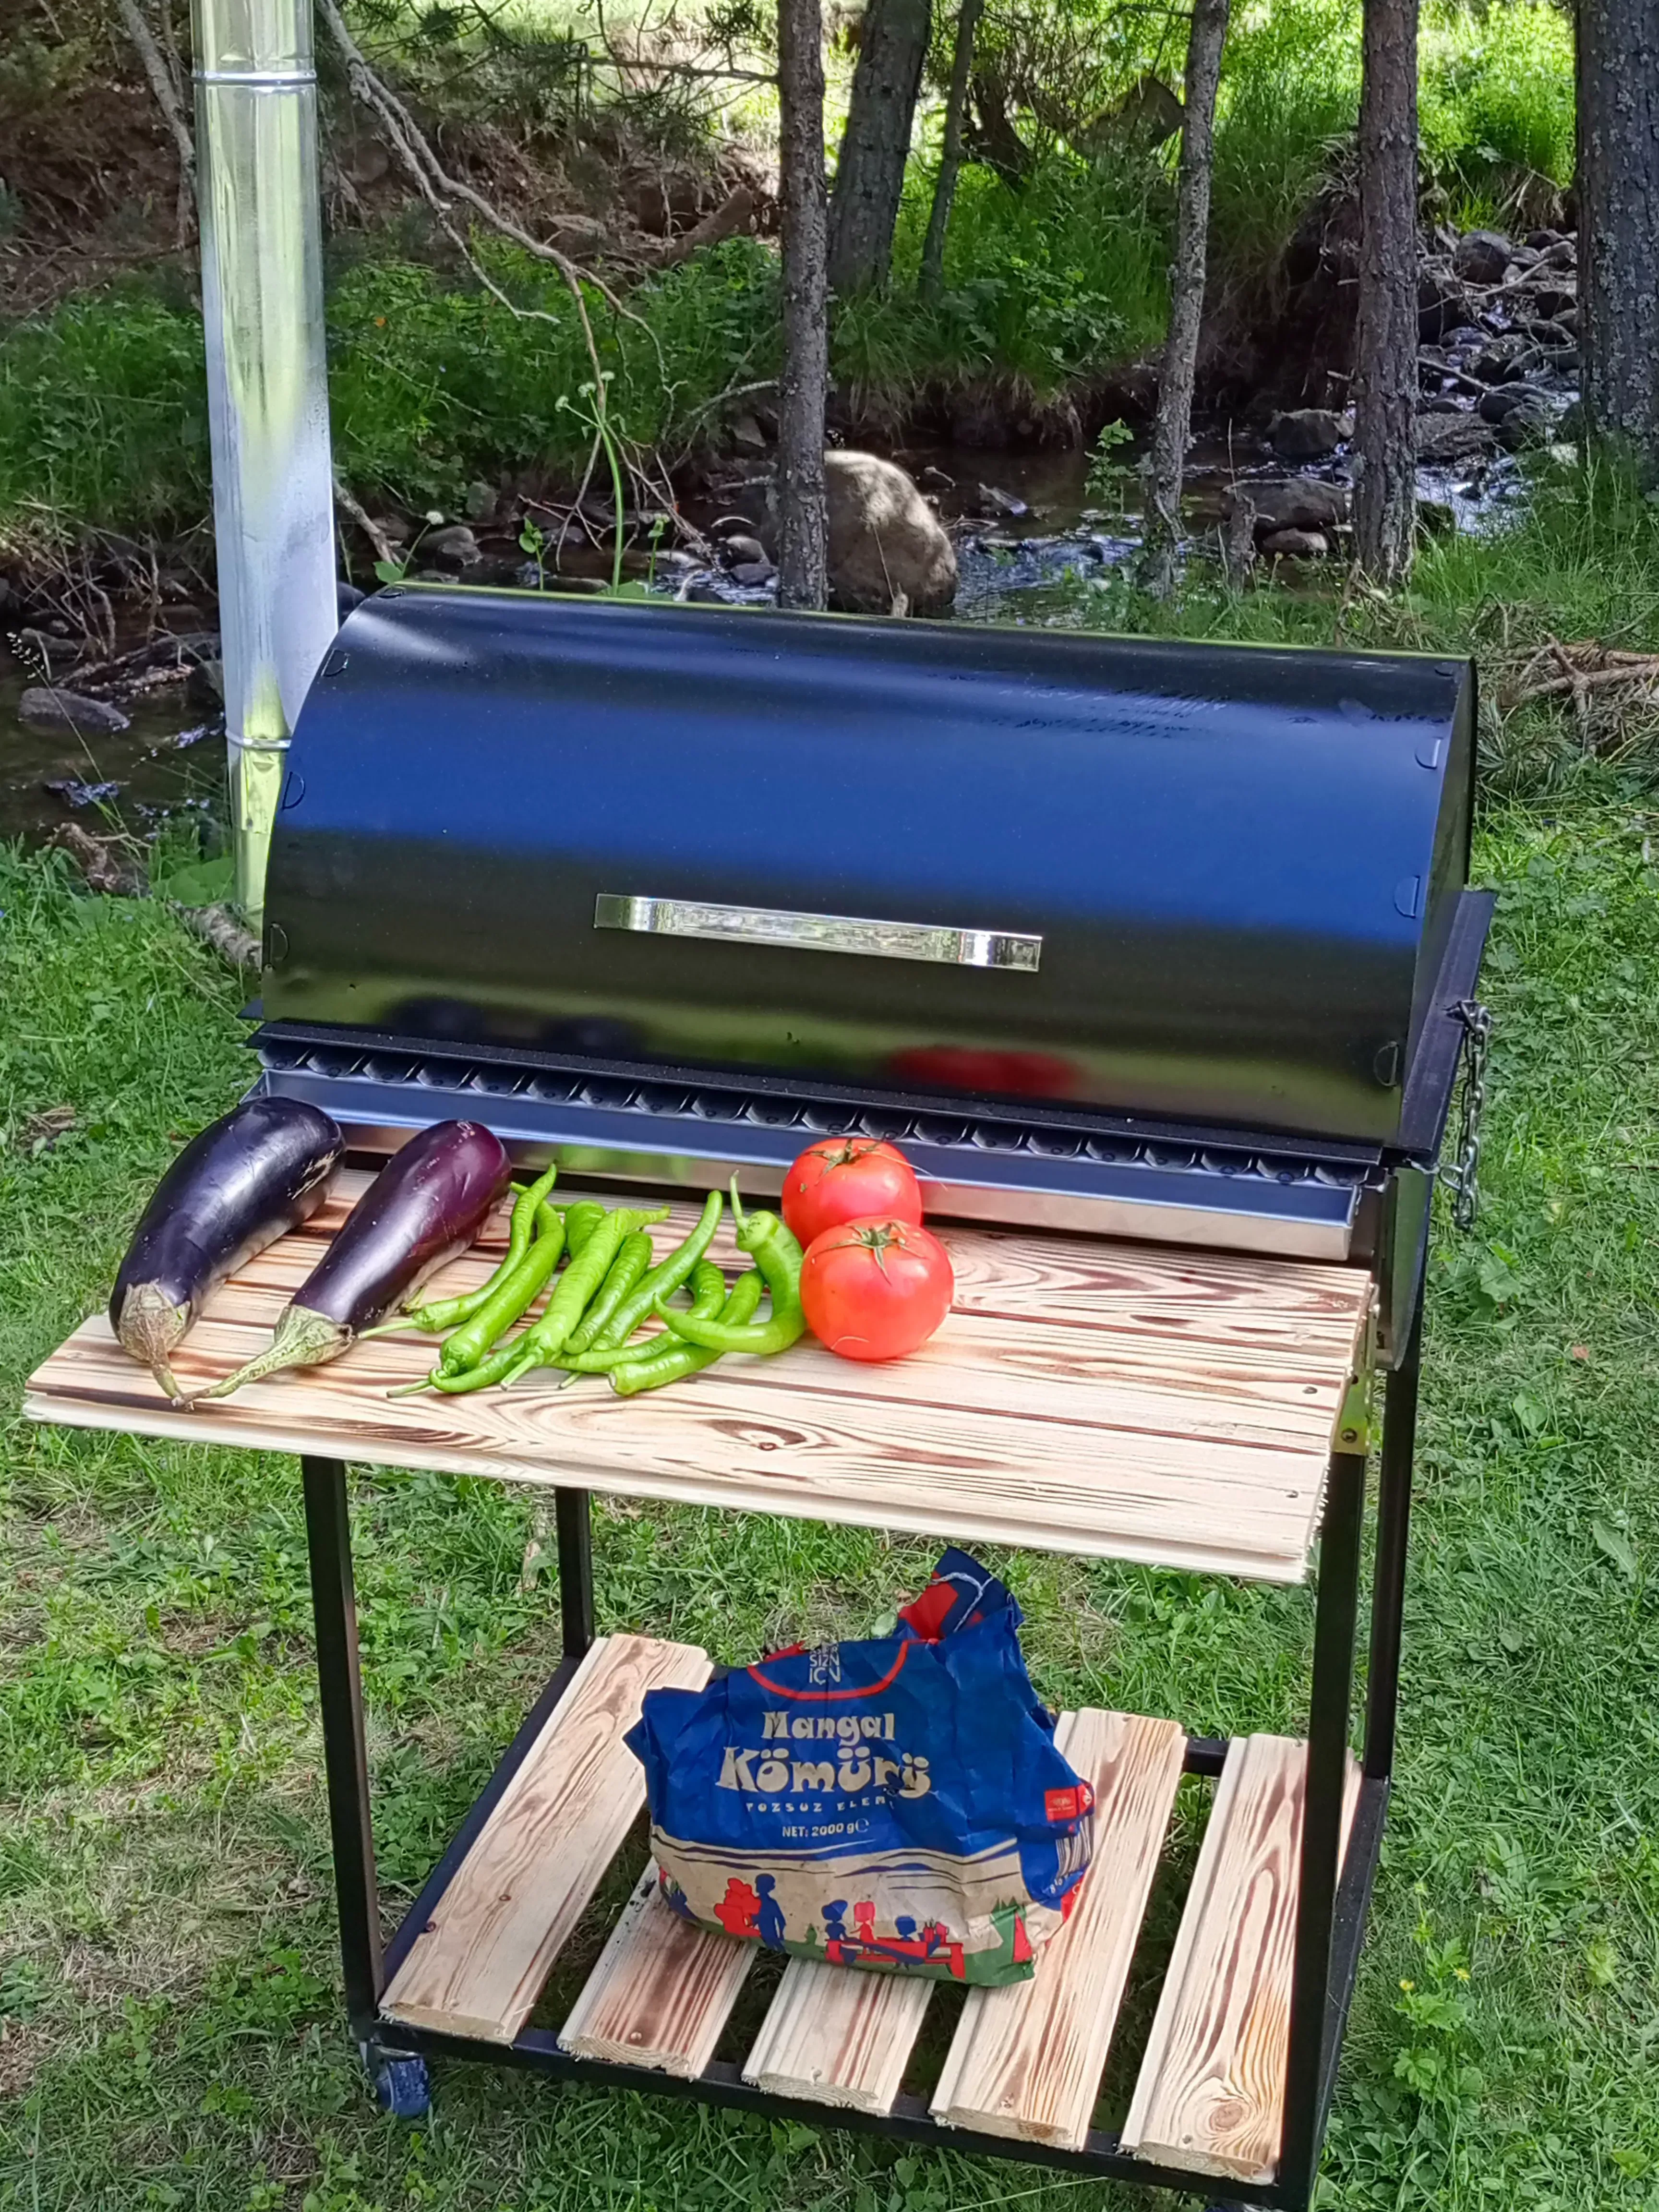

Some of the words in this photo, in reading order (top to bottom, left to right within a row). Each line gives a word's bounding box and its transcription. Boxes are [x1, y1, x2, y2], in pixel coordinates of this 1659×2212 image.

[761, 1711, 895, 1746] Mangal
[715, 1746, 931, 1799] Kömürü
[746, 1803, 822, 1813] TOZSUZ
[782, 1826, 808, 1838] NET:
[811, 1823, 844, 1837] 2000
